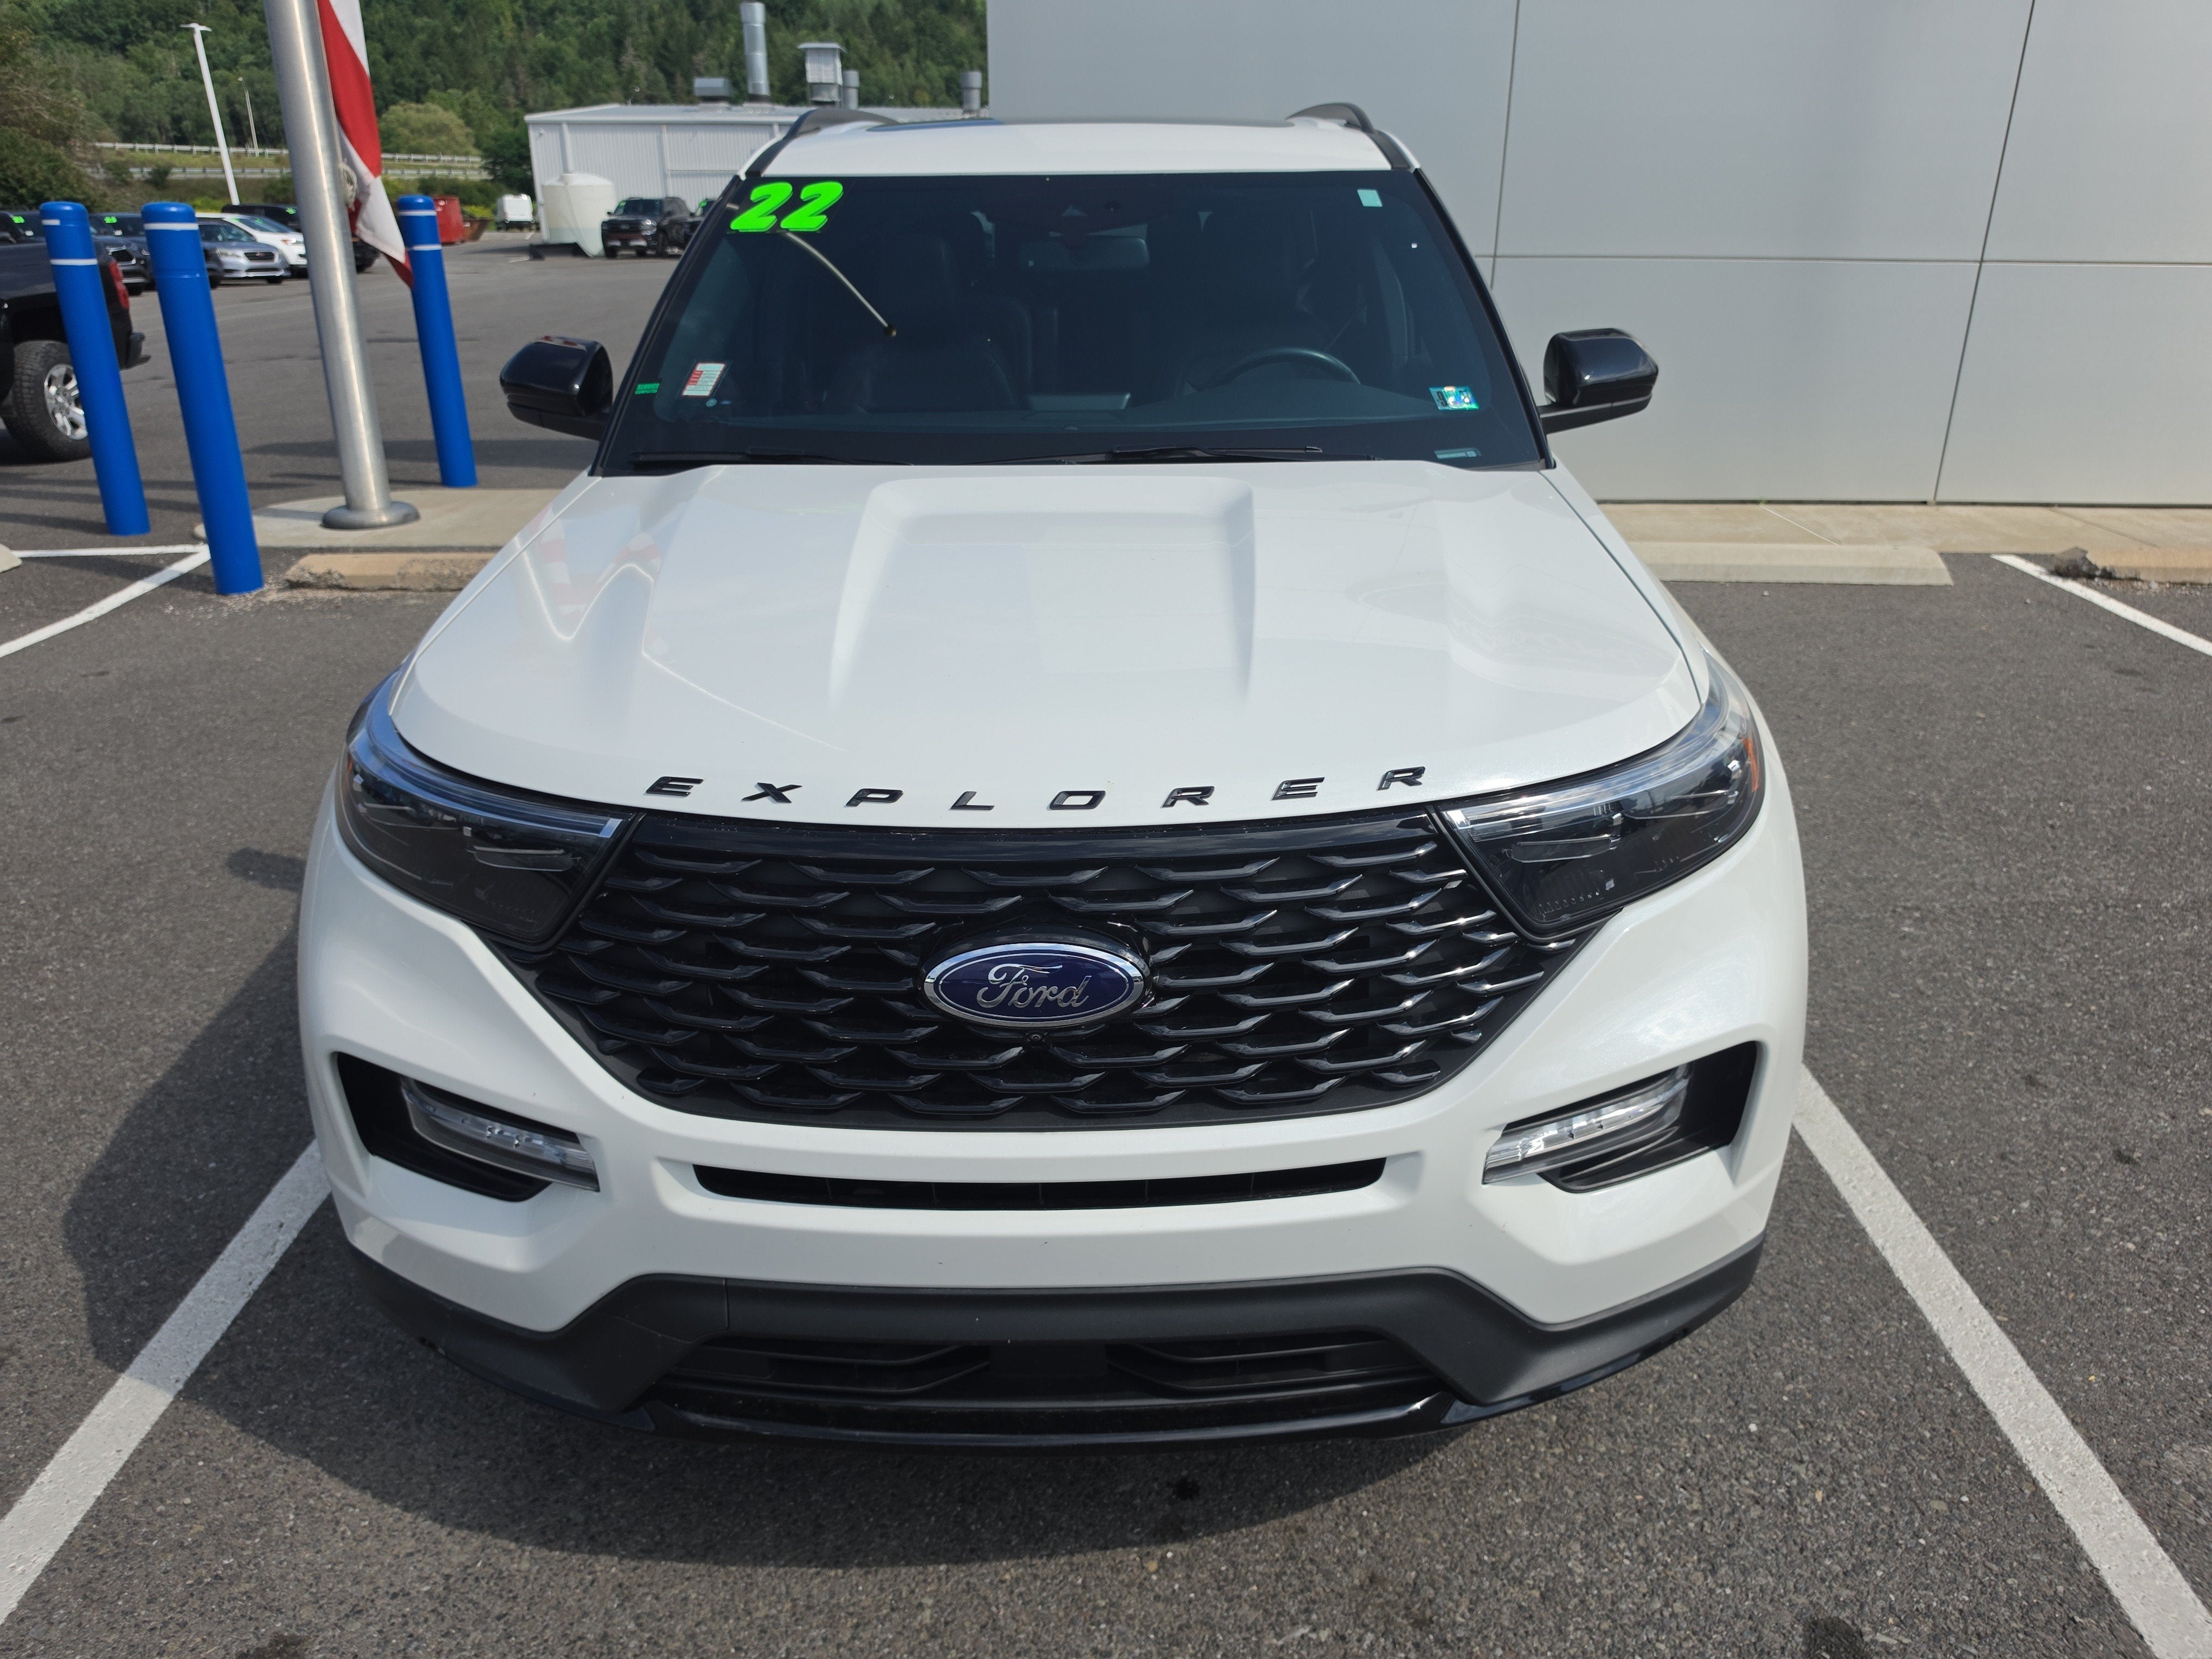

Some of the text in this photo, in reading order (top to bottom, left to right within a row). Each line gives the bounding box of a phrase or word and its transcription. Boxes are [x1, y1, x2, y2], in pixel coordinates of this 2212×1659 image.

[730, 181, 844, 232] 22
[645, 766, 1426, 810] EXPLORER
[976, 963, 1092, 1008] Ford
